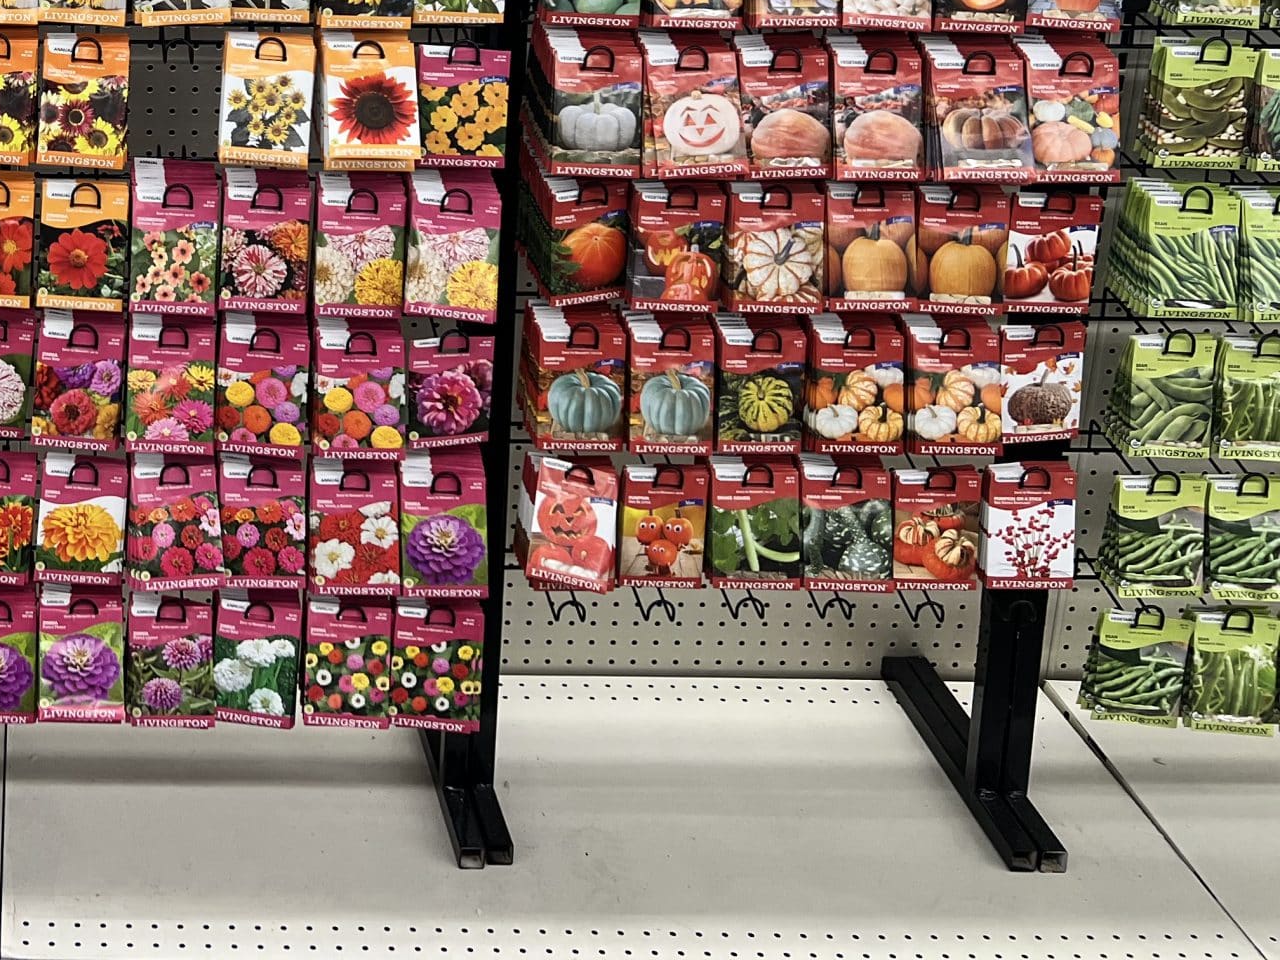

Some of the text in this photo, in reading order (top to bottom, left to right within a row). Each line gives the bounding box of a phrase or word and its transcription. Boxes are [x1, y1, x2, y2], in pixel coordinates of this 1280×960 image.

[661, 18, 738, 29] LIVINGSTON
[849, 16, 924, 29] LIVINGSTON
[1032, 18, 1112, 30] LIVINGSTON
[1182, 15, 1254, 26] LIVINGSTON
[421, 158, 498, 168] LIVINGSTON
[665, 165, 742, 177] LIVINGSTON
[751, 168, 826, 179] LIVINGSTON
[950, 170, 1027, 180] LIVINGSTON
[225, 302, 298, 311] LIVINGSTON
[635, 302, 710, 312] LIVINGSTON
[836, 301, 910, 311] LIVINGSTON
[1008, 305, 1082, 315] LIVINGSTON
[411, 306, 485, 320] LIVINGSTON
[1154, 310, 1230, 319] LIVINGSTON
[413, 435, 482, 448] LIVINGSTON
[1002, 433, 1072, 444] LIVINGSTON
[131, 443, 205, 453] LIVINGSTON
[222, 444, 296, 456] LIVINGSTON
[636, 445, 706, 454] LIVINGSTON
[822, 445, 897, 454] LIVINGSTON
[39, 573, 110, 584] LIVINGSTON
[226, 579, 298, 589] LIVINGSTON
[719, 581, 794, 590] LIVINGSTON
[897, 582, 970, 591] LIVINGSTON
[409, 589, 481, 598] LIVINGSTON
[44, 709, 115, 719] LIVINGSTON
[308, 717, 380, 728] LIVINGSTON
